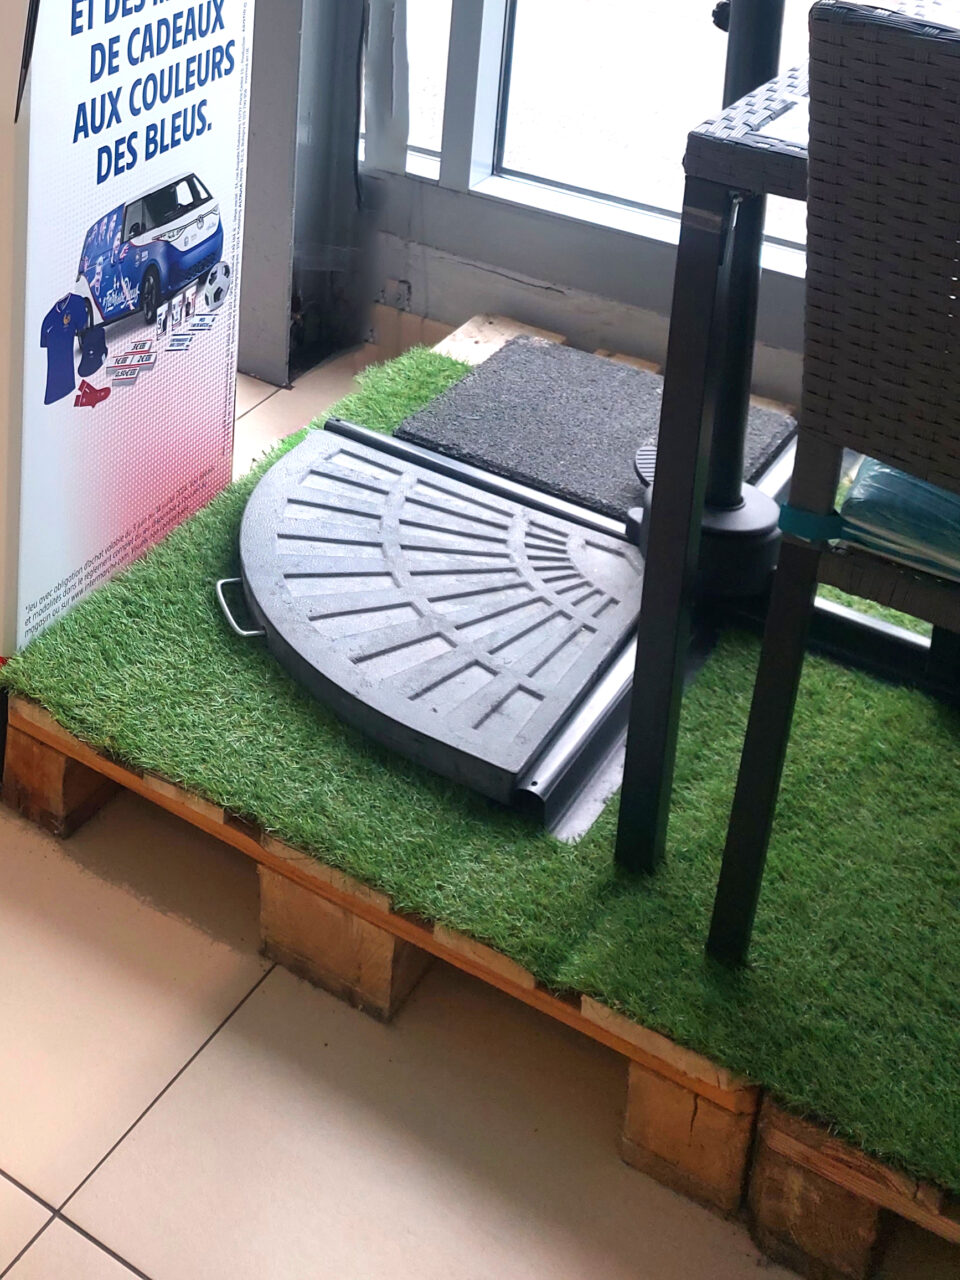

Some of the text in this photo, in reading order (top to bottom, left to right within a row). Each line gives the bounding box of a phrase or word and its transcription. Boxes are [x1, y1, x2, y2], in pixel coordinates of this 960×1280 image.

[73, 39, 235, 144] AUX COULEURS
[90, 35, 120, 83] DE
[97, 99, 213, 185] DES BLEUS.
